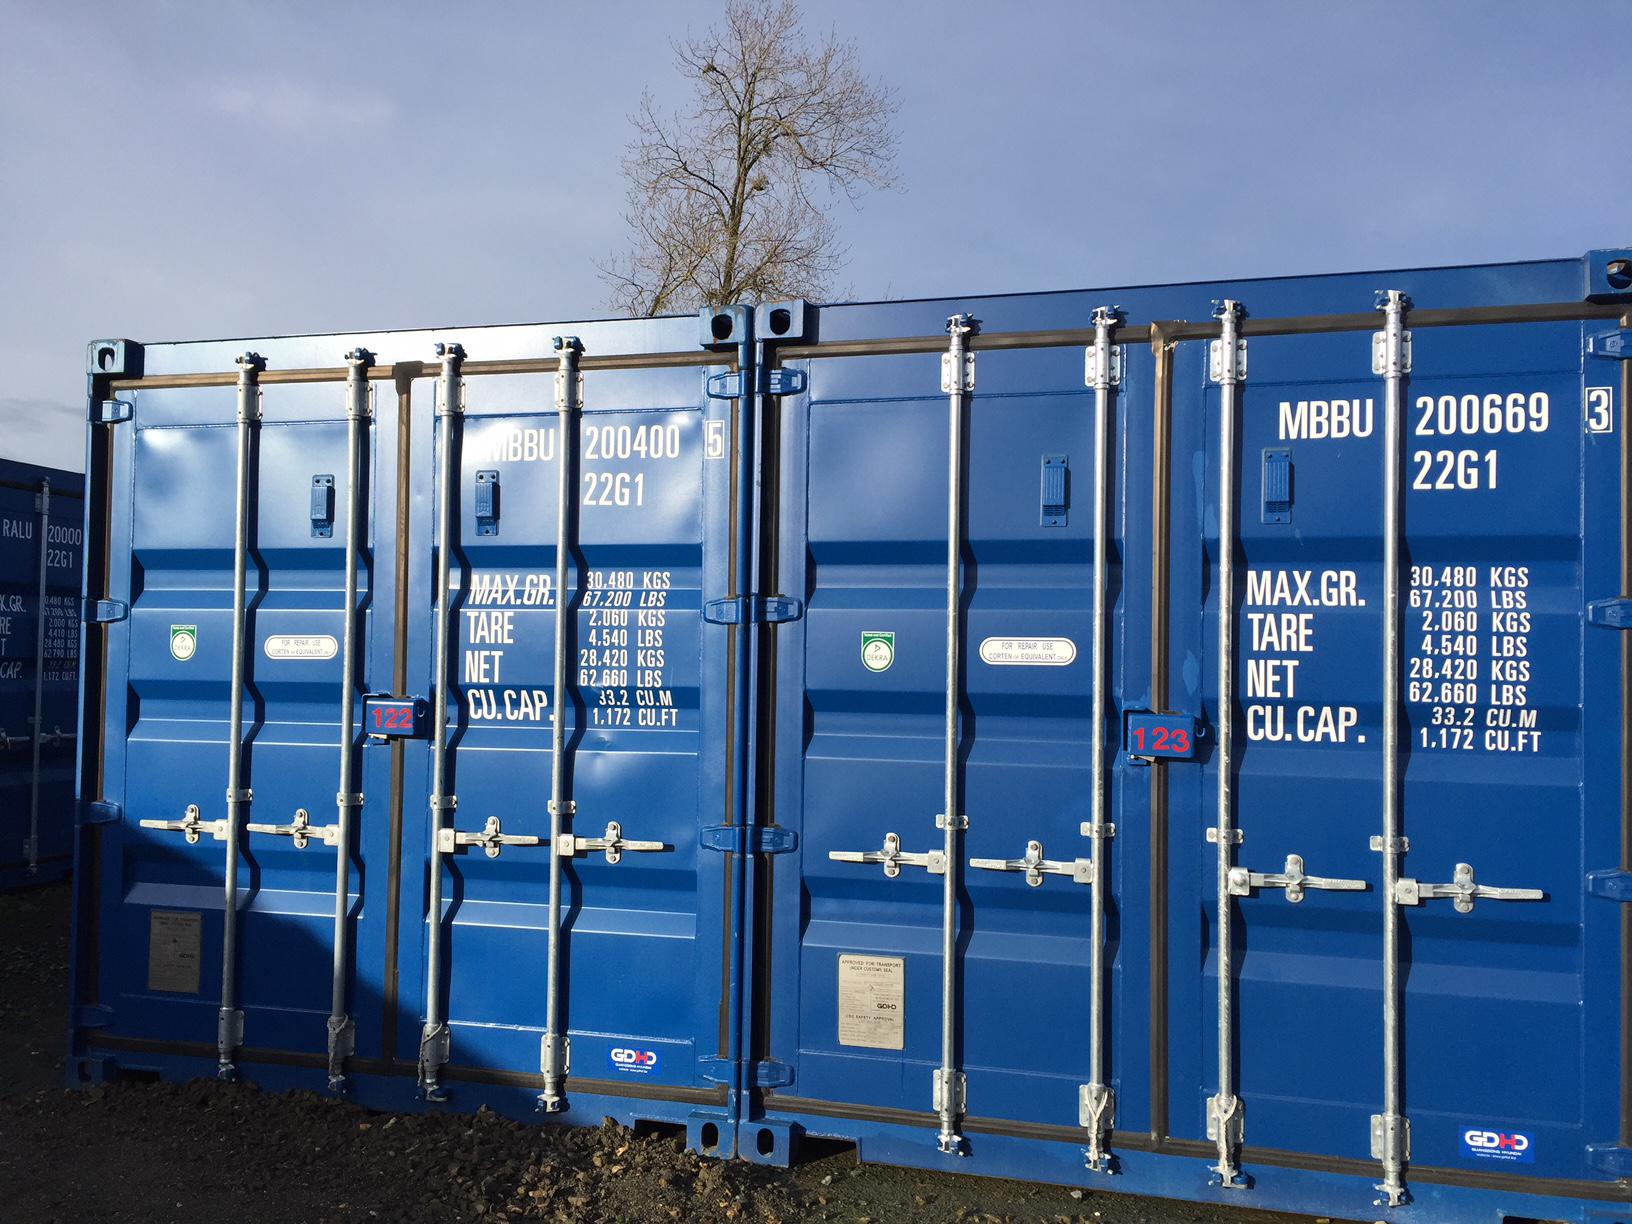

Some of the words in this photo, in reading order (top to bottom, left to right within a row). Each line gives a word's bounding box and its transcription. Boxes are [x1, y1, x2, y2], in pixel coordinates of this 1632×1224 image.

[1279, 399, 1373, 440] MBBU
[1415, 392, 1549, 435] 200669
[1588, 390, 1609, 430] 3
[585, 424, 680, 459] 200400
[707, 425, 722, 457] 5
[1413, 450, 1497, 489] 22G1
[583, 473, 643, 505] 22G1
[3, 519, 32, 539] RALU
[48, 525, 82, 545] 20000
[48, 549, 73, 568] 22G1
[587, 572, 634, 589] 30,480
[643, 572, 671, 589] KGS
[1411, 567, 1477, 587] 30,480
[1491, 567, 1529, 587] KGS
[468, 574, 555, 605] MAX.GR.
[583, 591, 632, 607] 67,200
[639, 592, 666, 607] LBS
[1247, 571, 1366, 606] MAX.GR.
[1410, 590, 1478, 608] 67,200
[1491, 591, 1527, 609] LBS
[467, 612, 514, 644] TARE
[588, 611, 628, 627] 2,060
[637, 611, 666, 627] KGS
[1422, 611, 1477, 632] 2,060
[1493, 612, 1531, 632] KGS
[67, 629, 78, 638] LBS
[588, 629, 628, 647] 4,540
[637, 630, 663, 647] LBS
[1248, 614, 1314, 651] TARE
[1001, 642, 1012, 650] FOR
[1018, 642, 1038, 650] REPAIR
[1042, 643, 1053, 651] USE
[1422, 635, 1477, 656] 4,540
[1492, 636, 1527, 657] LBS
[465, 651, 503, 683] NET
[580, 649, 628, 667] 28,420
[637, 650, 665, 667] KGS
[637, 670, 662, 687] LBS
[1248, 660, 1299, 697] NET
[1410, 658, 1477, 680] 28,420
[1492, 660, 1530, 681] KGS
[468, 689, 554, 721] CU.CAP.
[599, 690, 630, 706] 33.2
[636, 690, 673, 706] CU.M
[1409, 682, 1477, 704] 62,660
[1491, 685, 1527, 706] LBS
[372, 707, 413, 729] 122
[593, 708, 631, 726] 1,172
[638, 709, 679, 727] CU.FT
[1247, 705, 1366, 743] CU.CAP.
[1431, 707, 1475, 726] 33.2
[1486, 708, 1537, 728] CU.M
[1133, 726, 1191, 753] 123
[1420, 728, 1474, 750] 1,172
[1485, 730, 1541, 752] CU.FT
